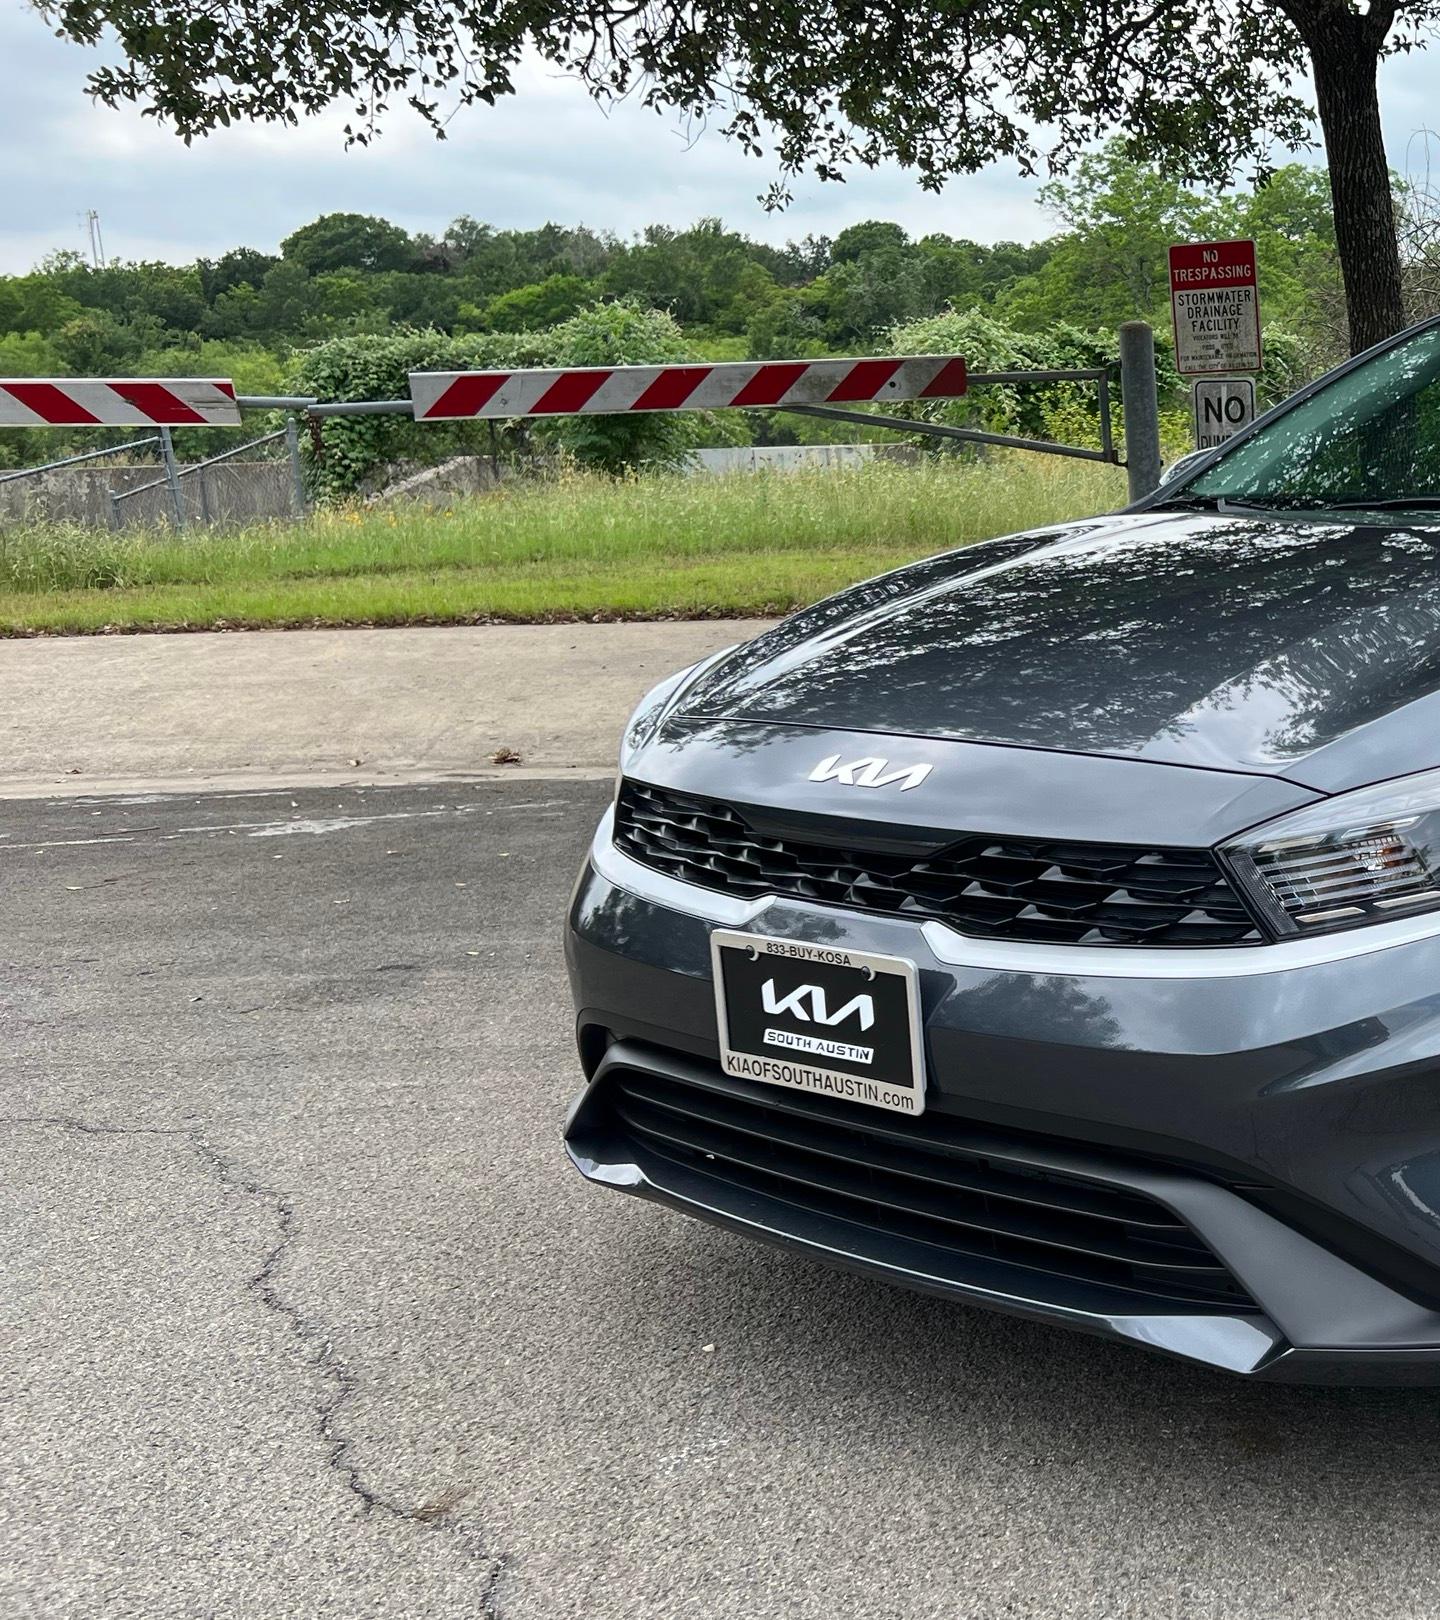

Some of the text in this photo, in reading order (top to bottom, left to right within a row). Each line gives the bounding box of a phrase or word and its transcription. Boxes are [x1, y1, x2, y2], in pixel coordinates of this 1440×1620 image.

[1203, 250, 1218, 263] NO
[1173, 265, 1251, 282] TRESPASSING
[1178, 290, 1251, 306] STORMWATER
[1187, 304, 1243, 319] DRAINAGE
[1192, 319, 1239, 332] FACILITY
[1204, 396, 1245, 423] NO
[1201, 435, 1232, 449] DUM
[808, 754, 934, 792] KIA
[766, 943, 851, 966] 833-BUY-KOSA
[761, 978, 875, 1032] KIA
[767, 1031, 871, 1061] SOUTH AUSTIN
[727, 1055, 914, 1110] KIAOFSOUTHAUSTIN.com
